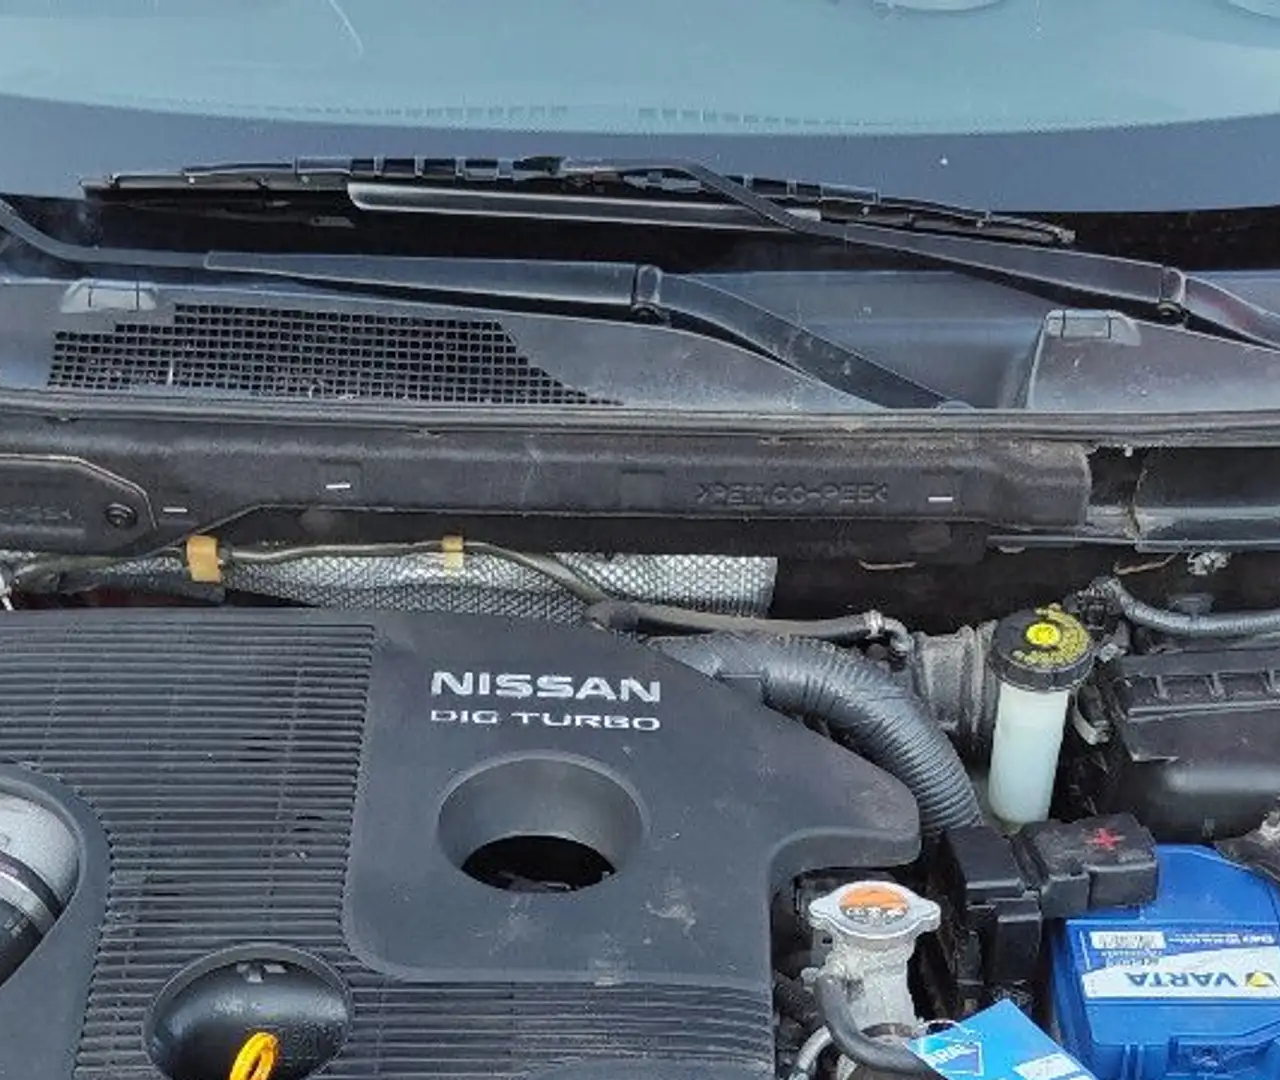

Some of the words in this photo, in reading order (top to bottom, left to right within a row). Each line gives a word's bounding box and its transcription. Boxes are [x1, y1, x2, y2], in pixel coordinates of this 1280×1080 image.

[431, 671, 661, 703] NISSAN
[431, 709, 498, 724] DIG
[511, 711, 661, 731] TURBO
[1125, 971, 1237, 988] VARTA
